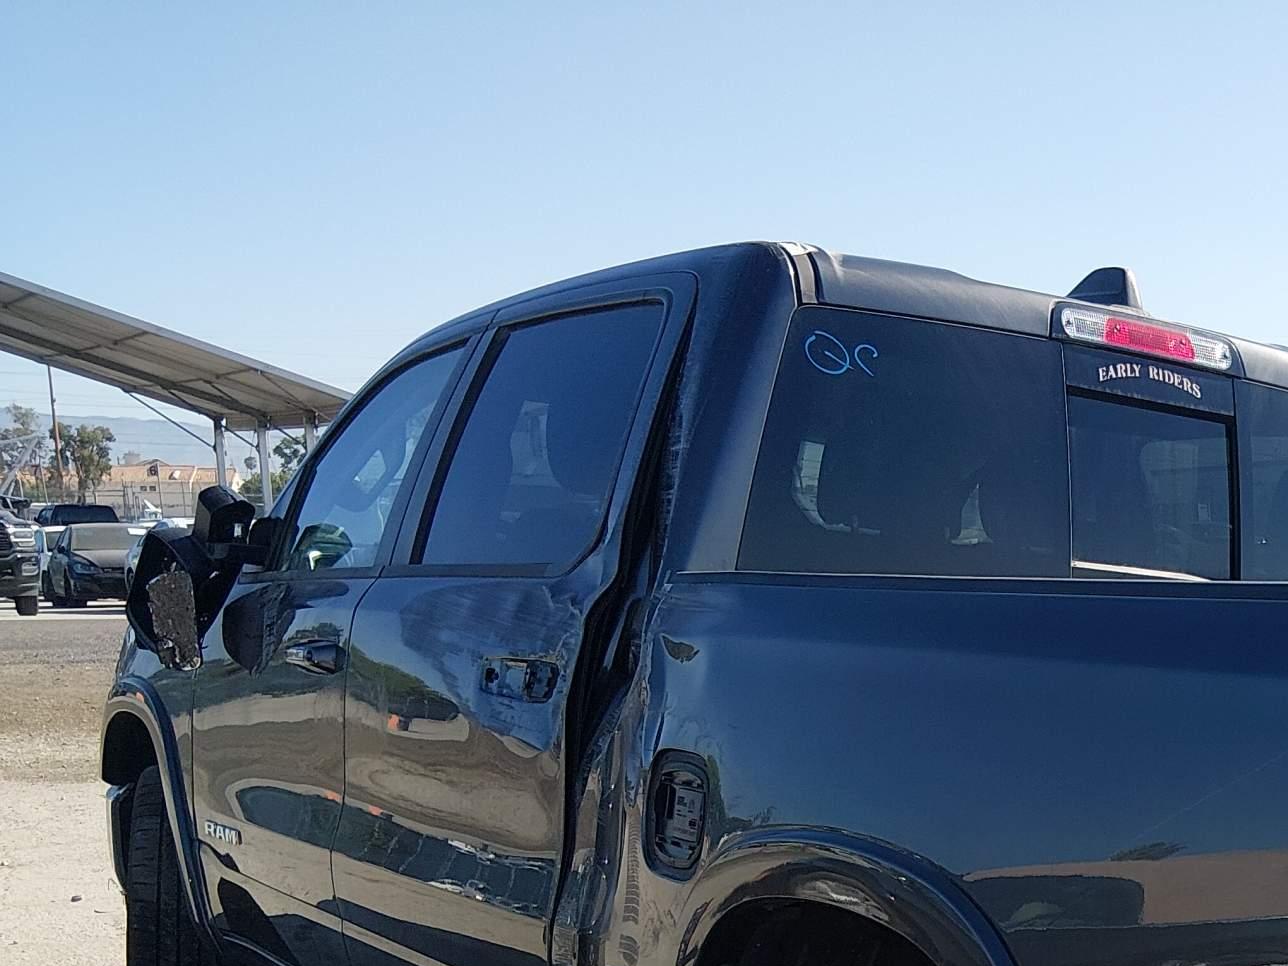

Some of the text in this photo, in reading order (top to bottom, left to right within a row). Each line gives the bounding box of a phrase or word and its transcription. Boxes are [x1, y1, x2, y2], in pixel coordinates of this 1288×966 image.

[1098, 363, 1202, 399] EARLY RIDERS
[204, 820, 243, 846] RAM
